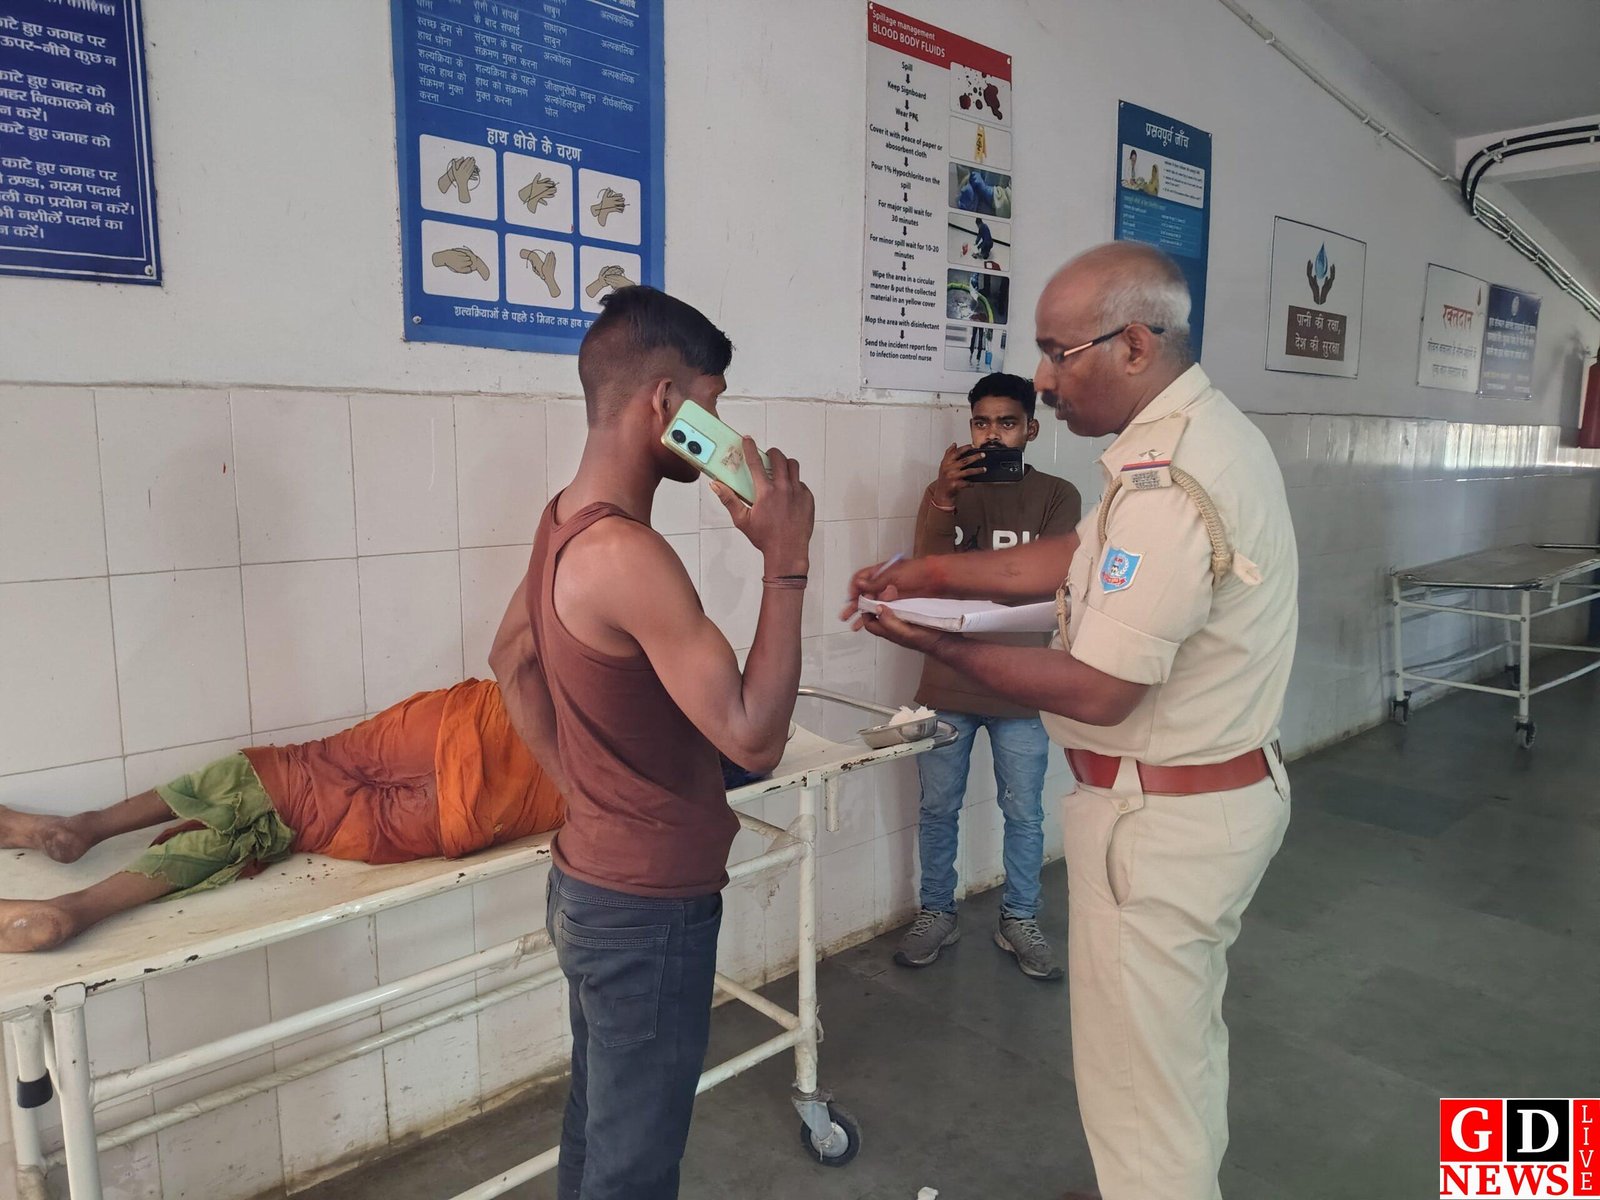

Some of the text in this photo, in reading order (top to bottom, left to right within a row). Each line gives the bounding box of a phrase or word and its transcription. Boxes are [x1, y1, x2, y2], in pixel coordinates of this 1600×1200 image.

[872, 9, 936, 41] Spillage management
[22, 22, 107, 48] हुए जगह पर
[872, 22, 946, 58] BLOOD BODY FLUIDS
[74, 50, 117, 66] कुछ न
[901, 61, 913, 72] Spill
[27, 74, 106, 98] हुए जहर को
[887, 80, 927, 100] Keep Signboard
[30, 90, 115, 116] निकालने की
[895, 107, 908, 118] Wear
[28, 126, 111, 148] हुए जगह को
[869, 123, 884, 134] Cover
[889, 130, 901, 139] with
[901, 135, 916, 144] peace
[922, 141, 937, 149] paper
[1145, 122, 1174, 147] प्रसवपूर्व
[486, 127, 582, 162] हाथ धोने के चरण
[914, 150, 927, 159] cloth
[2, 157, 118, 182] काटे हुए जगह पर
[871, 161, 883, 171] Pour
[884, 164, 892, 173] 1%
[932, 177, 940, 186] the
[50, 180, 82, 193] गरम
[86, 185, 121, 198] पदार्थ
[900, 182, 912, 190] spill
[24, 193, 44, 206] का
[48, 196, 87, 210] प्रयोग
[91, 201, 103, 212] न
[878, 199, 933, 218] For major spill wait for
[66, 214, 101, 228] पदार्थ
[104, 219, 123, 231] का
[891, 214, 919, 227] 30 minutes
[869, 233, 940, 253] For minor spill wait for 10-20
[894, 250, 915, 260] minutes
[872, 269, 885, 279] Wipe
[885, 272, 895, 280] the
[895, 273, 906, 282] area
[916, 276, 936, 286] circular
[870, 282, 890, 291] manner
[905, 286, 914, 294] the
[914, 287, 937, 297] collected
[870, 294, 892, 302] material
[905, 297, 921, 306] yellow
[922, 300, 936, 308] cover
[501, 308, 510, 321] से
[511, 310, 527, 323] पहले
[864, 315, 877, 325] Mop
[877, 317, 886, 325] the
[898, 319, 910, 327] with
[910, 320, 940, 330] disinfectant
[1296, 311, 1312, 328] पानी
[1315, 313, 1325, 330] की
[864, 338, 938, 352] Send the incident report form
[1295, 332, 1340, 358] देश की सुरक्षा
[869, 350, 876, 358] to
[876, 350, 899, 359] infection
[899, 353, 917, 361] control
